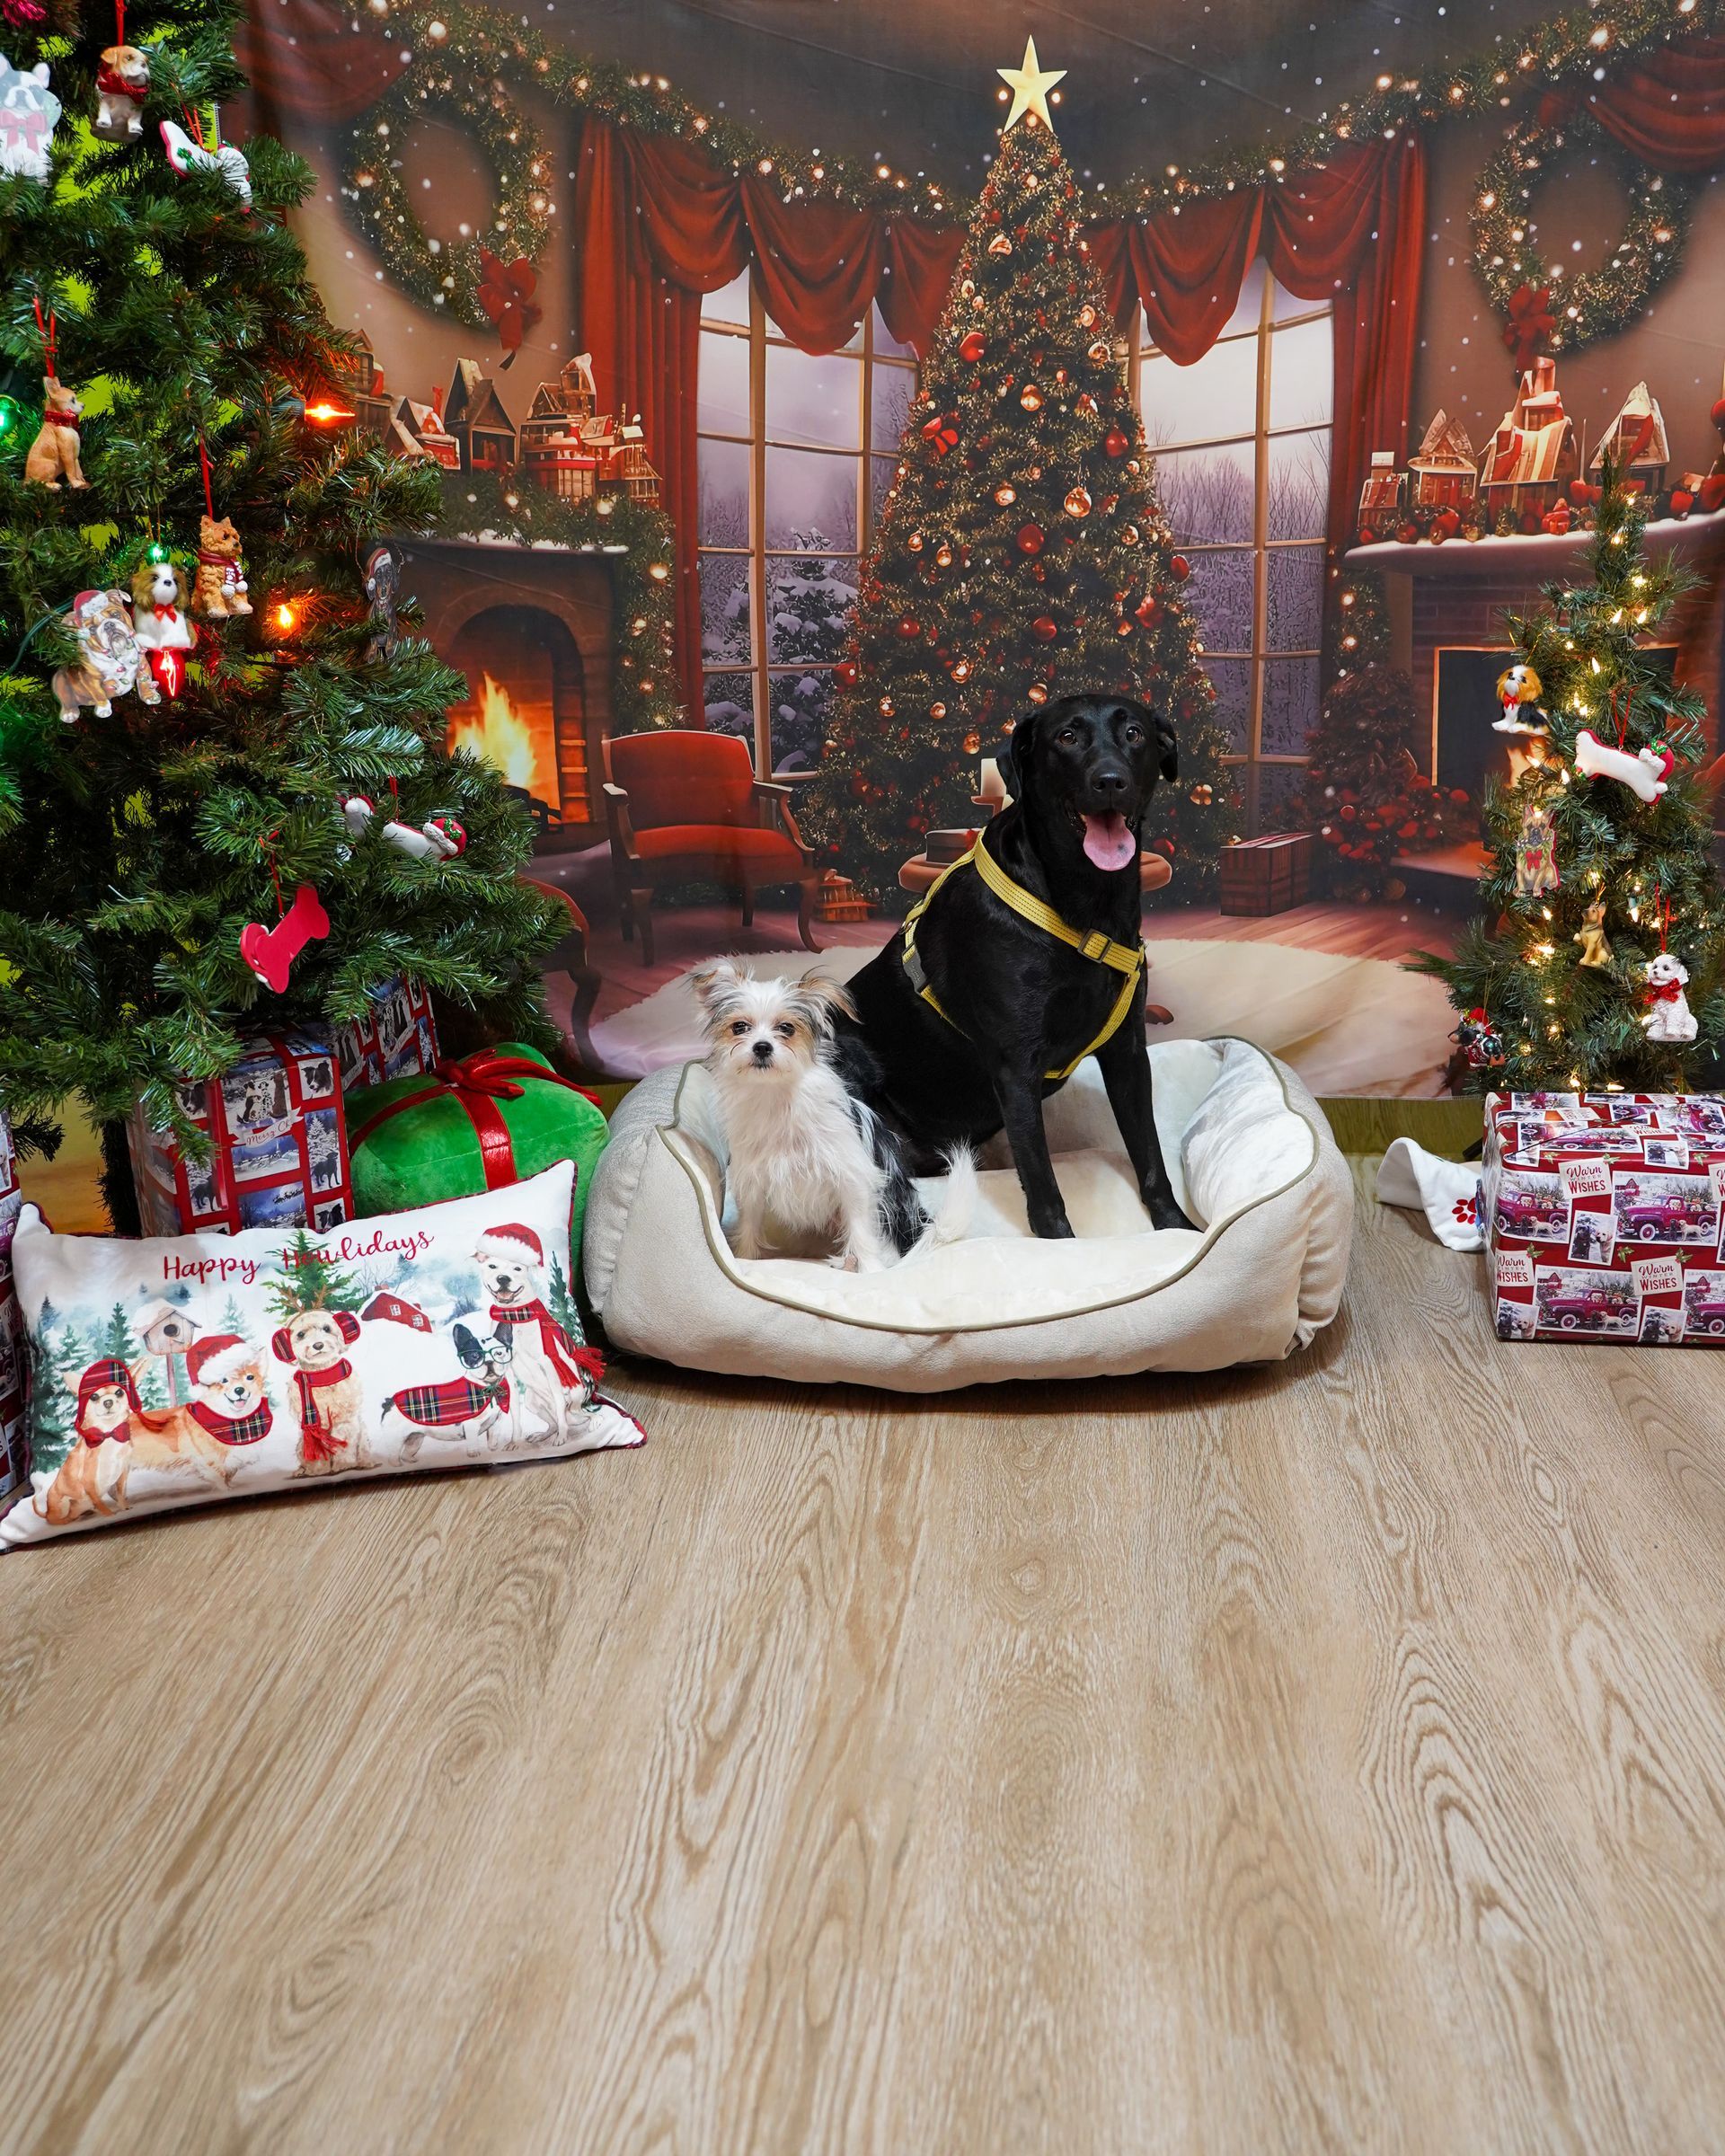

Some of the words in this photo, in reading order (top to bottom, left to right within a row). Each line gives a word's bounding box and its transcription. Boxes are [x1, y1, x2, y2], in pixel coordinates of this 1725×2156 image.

[1566, 1165, 1602, 1178] Warm
[1568, 1180, 1606, 1194] WISHES
[164, 1255, 261, 1285] Happy
[283, 1230, 435, 1270] Howlidays
[1639, 1263, 1674, 1276] Warm
[1640, 1277, 1676, 1291] WISHES
